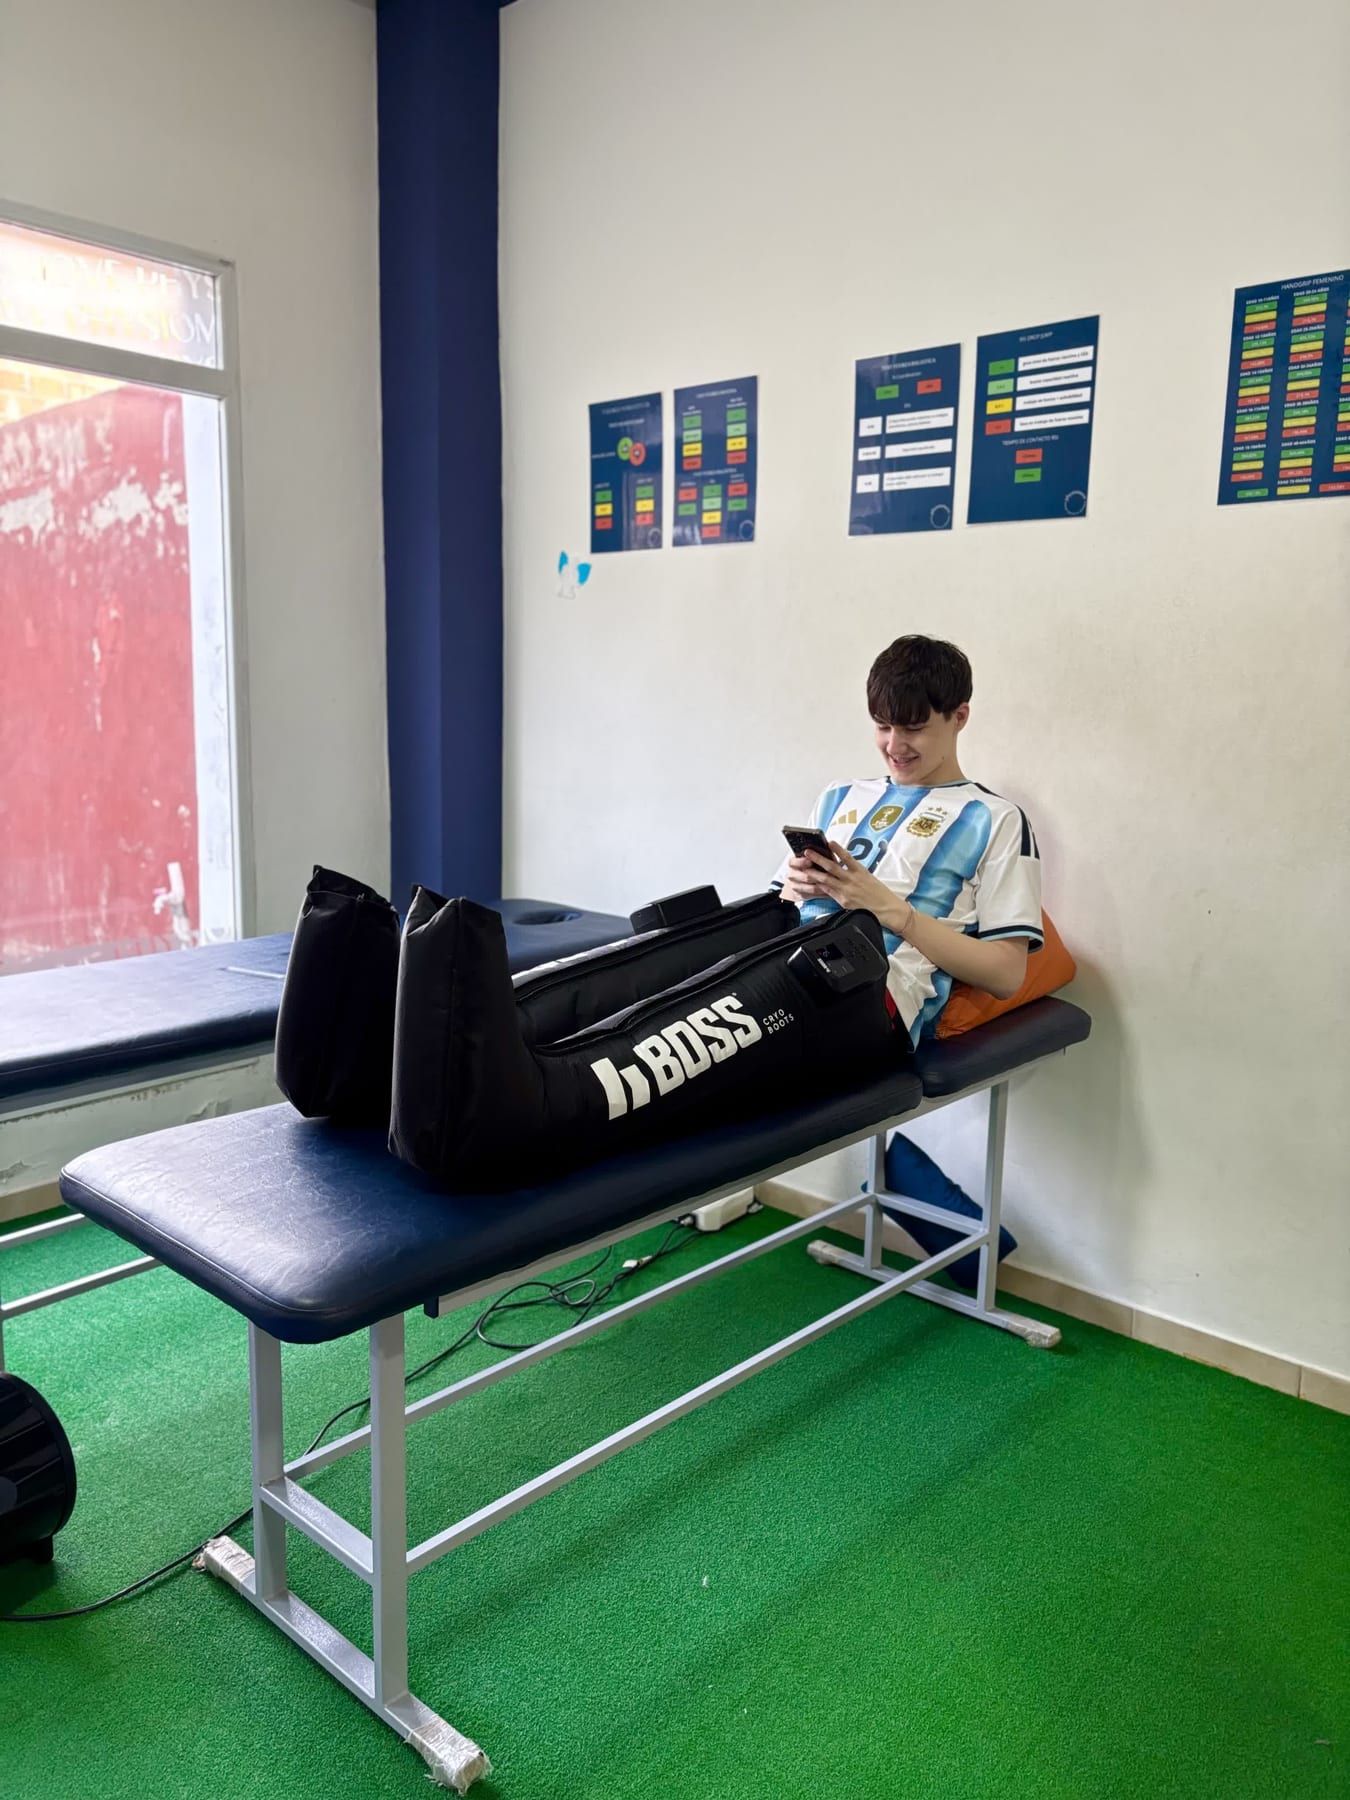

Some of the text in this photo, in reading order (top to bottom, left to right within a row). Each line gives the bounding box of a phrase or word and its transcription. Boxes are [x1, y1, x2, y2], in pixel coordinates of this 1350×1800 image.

[1312, 275, 1344, 285] FEMENINO
[763, 1008, 785, 1026] CRYO
[767, 1013, 794, 1034] BOOTS
[633, 995, 763, 1096] BOSS
